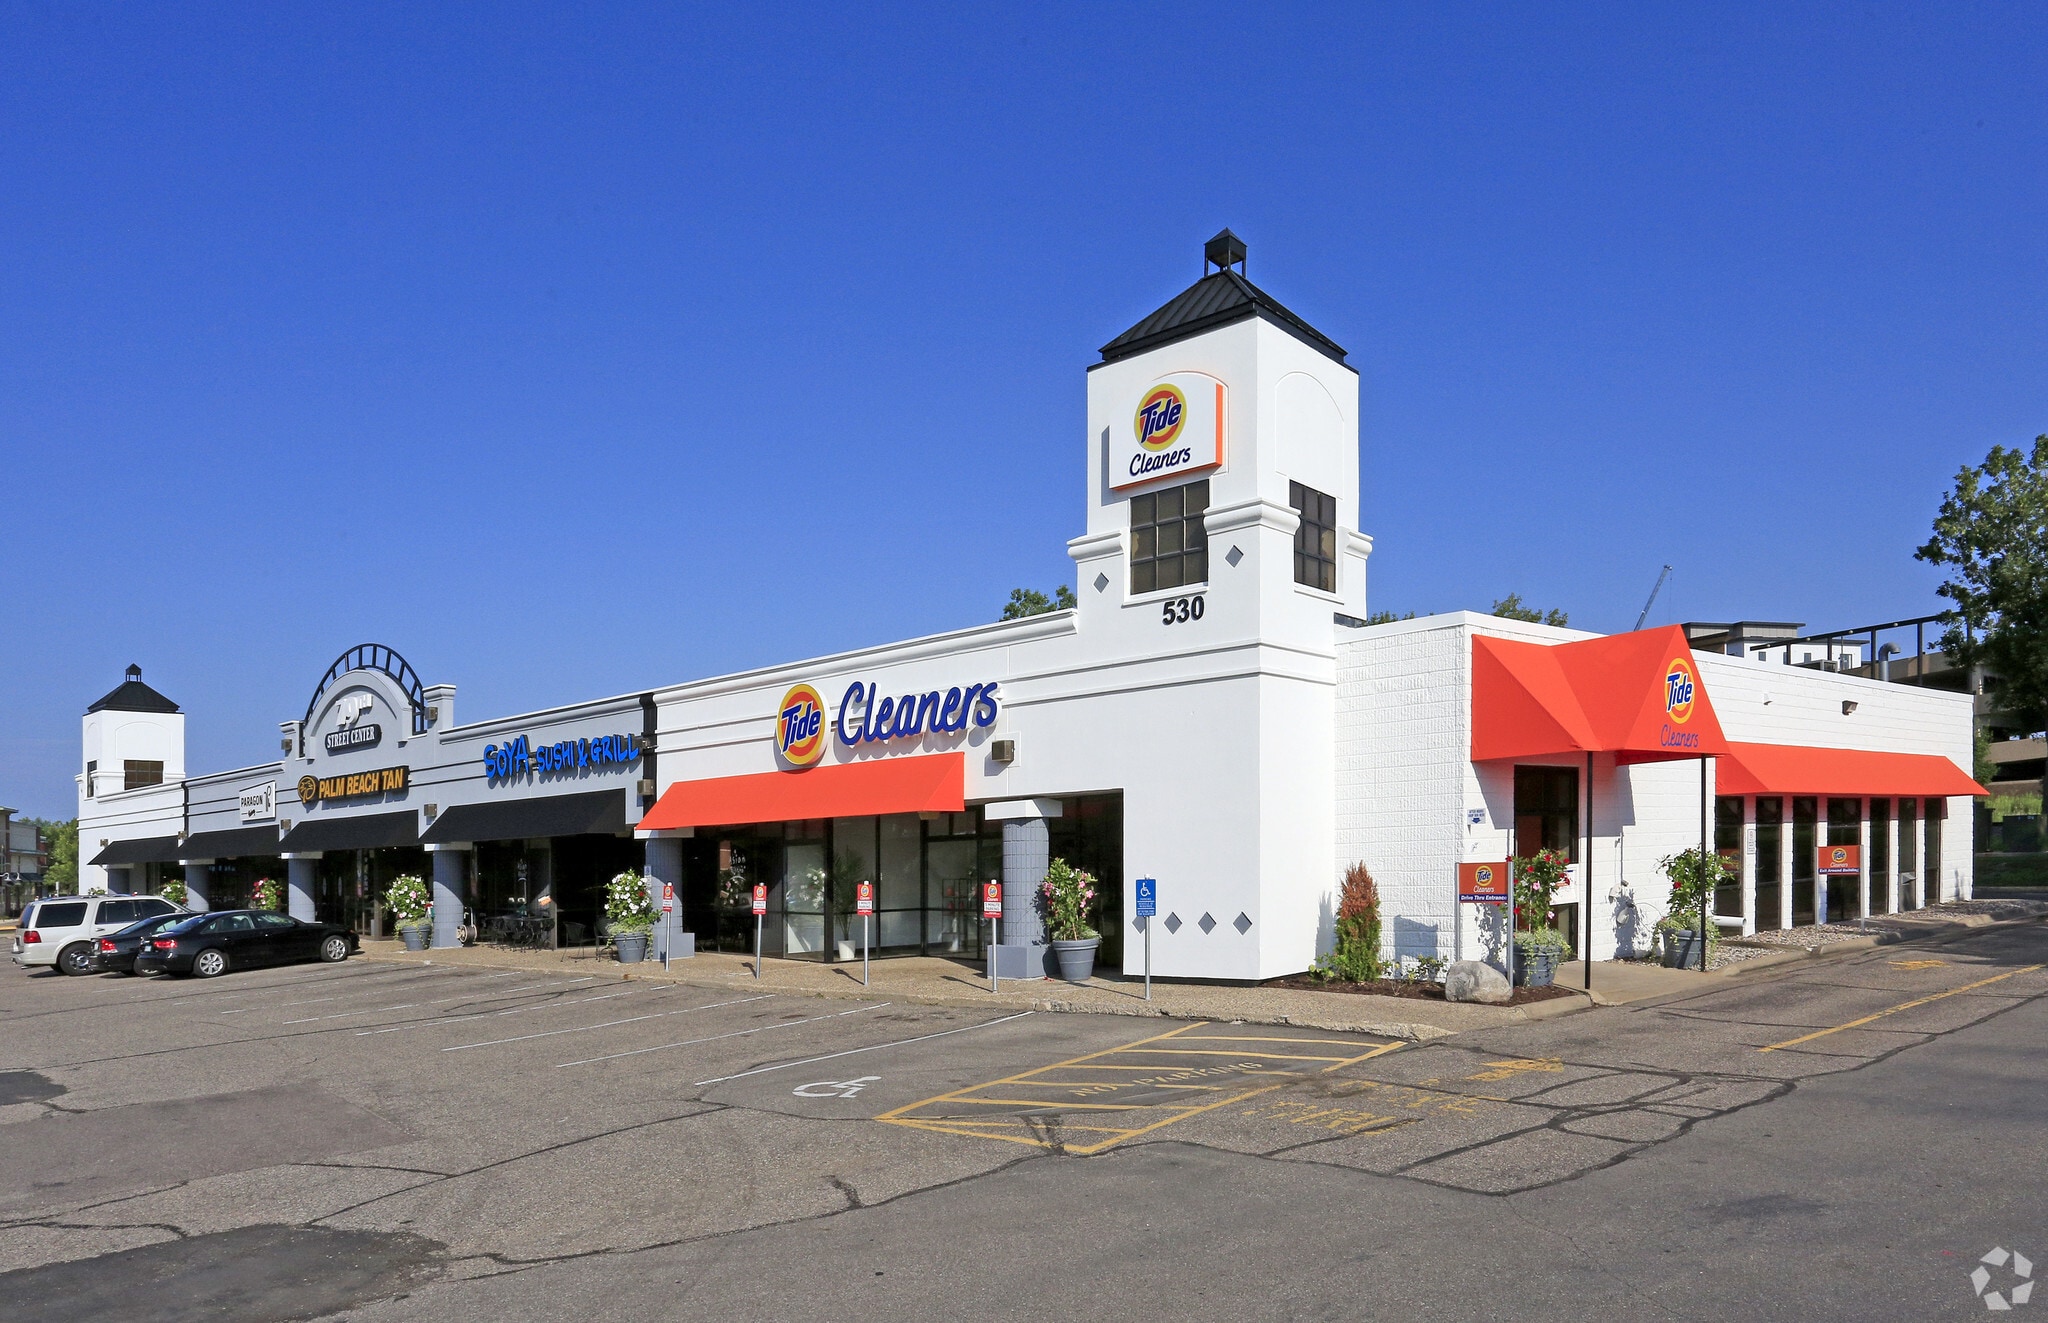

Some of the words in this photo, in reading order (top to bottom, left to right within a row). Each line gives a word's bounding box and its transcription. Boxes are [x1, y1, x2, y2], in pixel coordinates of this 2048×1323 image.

[1139, 396, 1182, 444] Tide
[1129, 447, 1191, 476] Cleaners
[1162, 595, 1205, 626] 530
[1666, 671, 1694, 713] Tide
[781, 700, 822, 755] Tide
[837, 681, 999, 746] Cleaners
[326, 731, 350, 748] STREET
[350, 726, 375, 744] CENTER
[1660, 724, 1699, 748] Cleaners
[536, 740, 575, 773] SUSHI
[577, 737, 589, 768] &
[590, 733, 640, 765] GRILL
[318, 776, 345, 799] PALM
[346, 772, 379, 795] BEACH
[382, 768, 404, 790] TAN
[240, 795, 263, 807] PARAGON
[1473, 885, 1495, 893] Cleaners
[1477, 869, 1491, 883] Tide
[1132, 1062, 1264, 1085] PARKING
